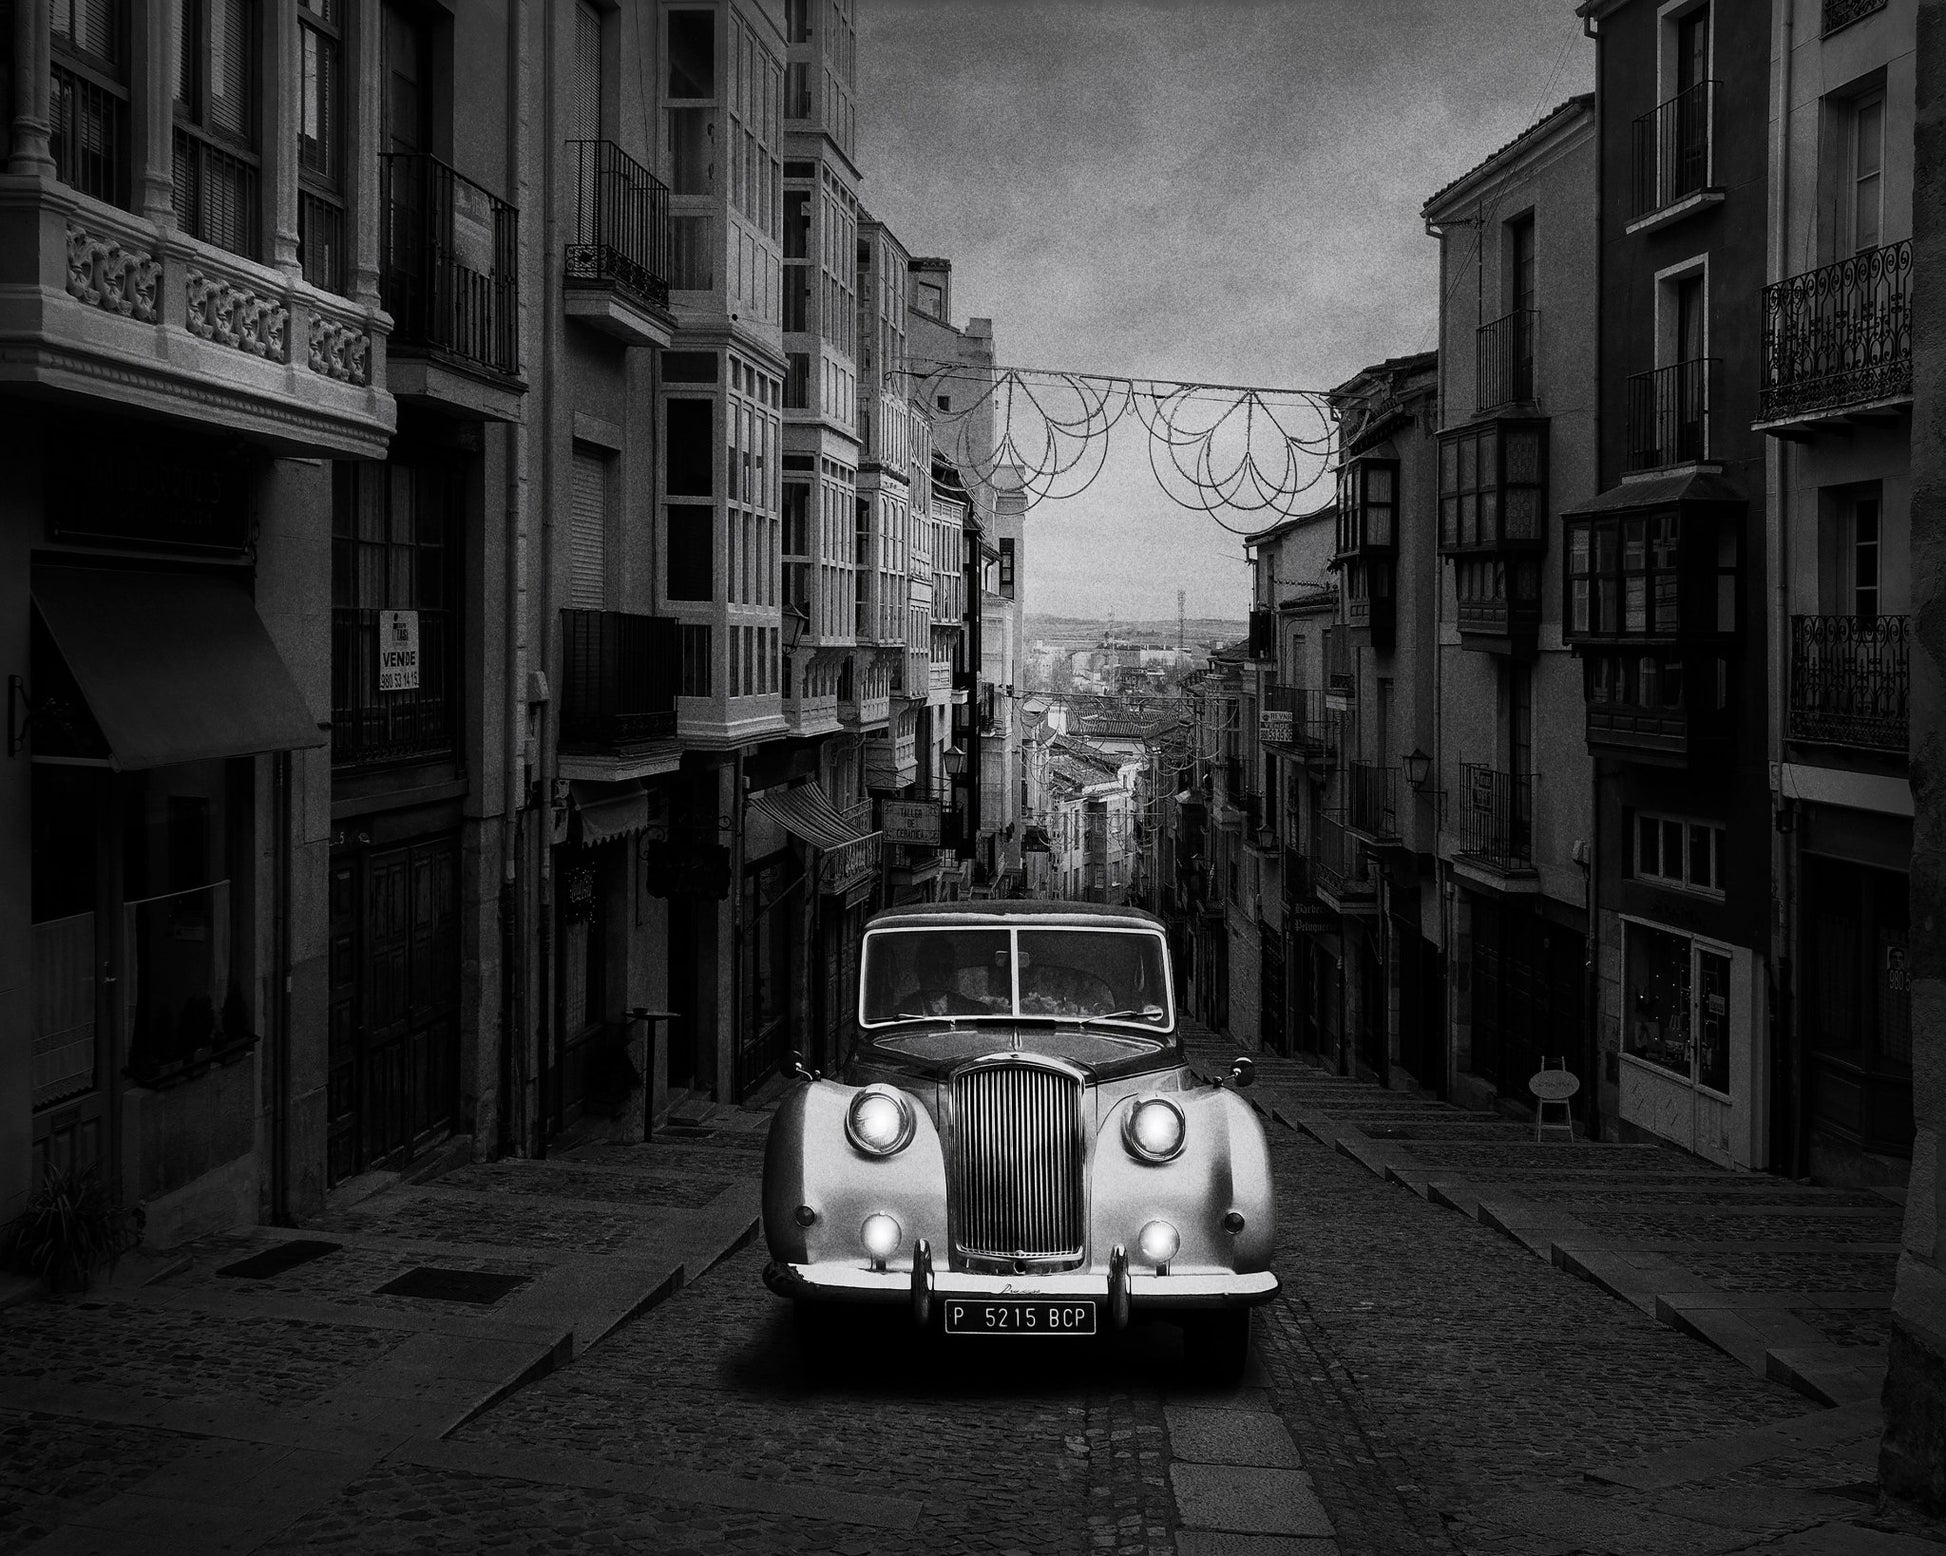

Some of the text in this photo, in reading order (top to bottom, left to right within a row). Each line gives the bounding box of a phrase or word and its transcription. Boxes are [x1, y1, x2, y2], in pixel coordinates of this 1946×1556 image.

[383, 651, 416, 667] VENDE
[900, 807, 923, 818] TALLER
[907, 818, 915, 828] DE
[1889, 969, 1904, 990] 980
[954, 1307, 1085, 1328] P 5215 BCP
